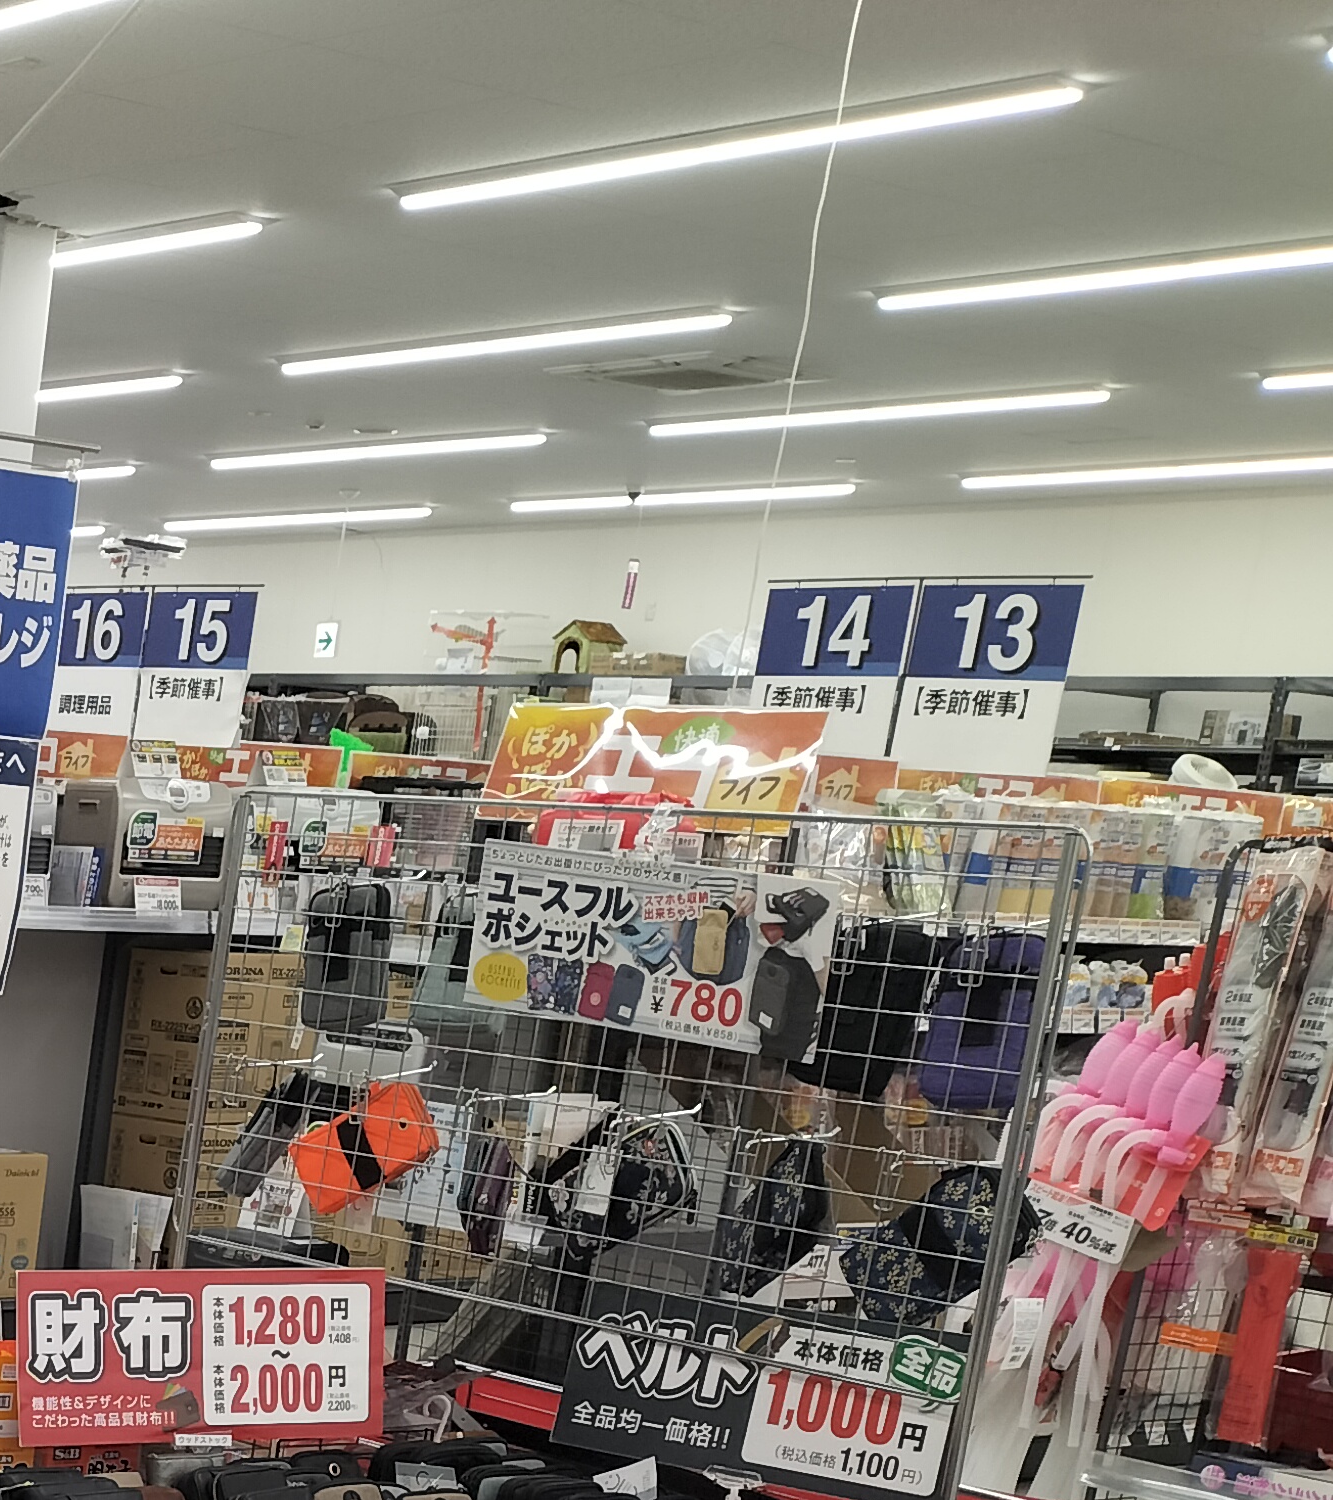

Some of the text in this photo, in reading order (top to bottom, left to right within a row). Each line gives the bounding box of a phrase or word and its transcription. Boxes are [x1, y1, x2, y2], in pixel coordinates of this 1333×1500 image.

[71, 598, 232, 663] 16 15
[797, 593, 1038, 672] 14 13
[58, 694, 112, 716] 調理用品
[63, 752, 91, 770] ライフ
[486, 871, 635, 925] ユースフル
[643, 891, 709, 907] スマホも収納
[643, 904, 703, 921] 出来ちゃう!
[481, 908, 614, 959] ポシェット
[30, 1291, 190, 1379] 財布
[212, 1296, 225, 1348] 本体価格
[578, 1314, 756, 1404] ベルト
[793, 1338, 884, 1374] 本体価格
[893, 1351, 965, 1393] 全品
[31, 1394, 151, 1412] 機能性&デザインに
[213, 1364, 226, 1415] 本体価格
[765, 1368, 929, 1453] 1,000円
[31, 1411, 176, 1429] こだわった高品質財布!!
[571, 1400, 732, 1451] 全品均一価格!!
